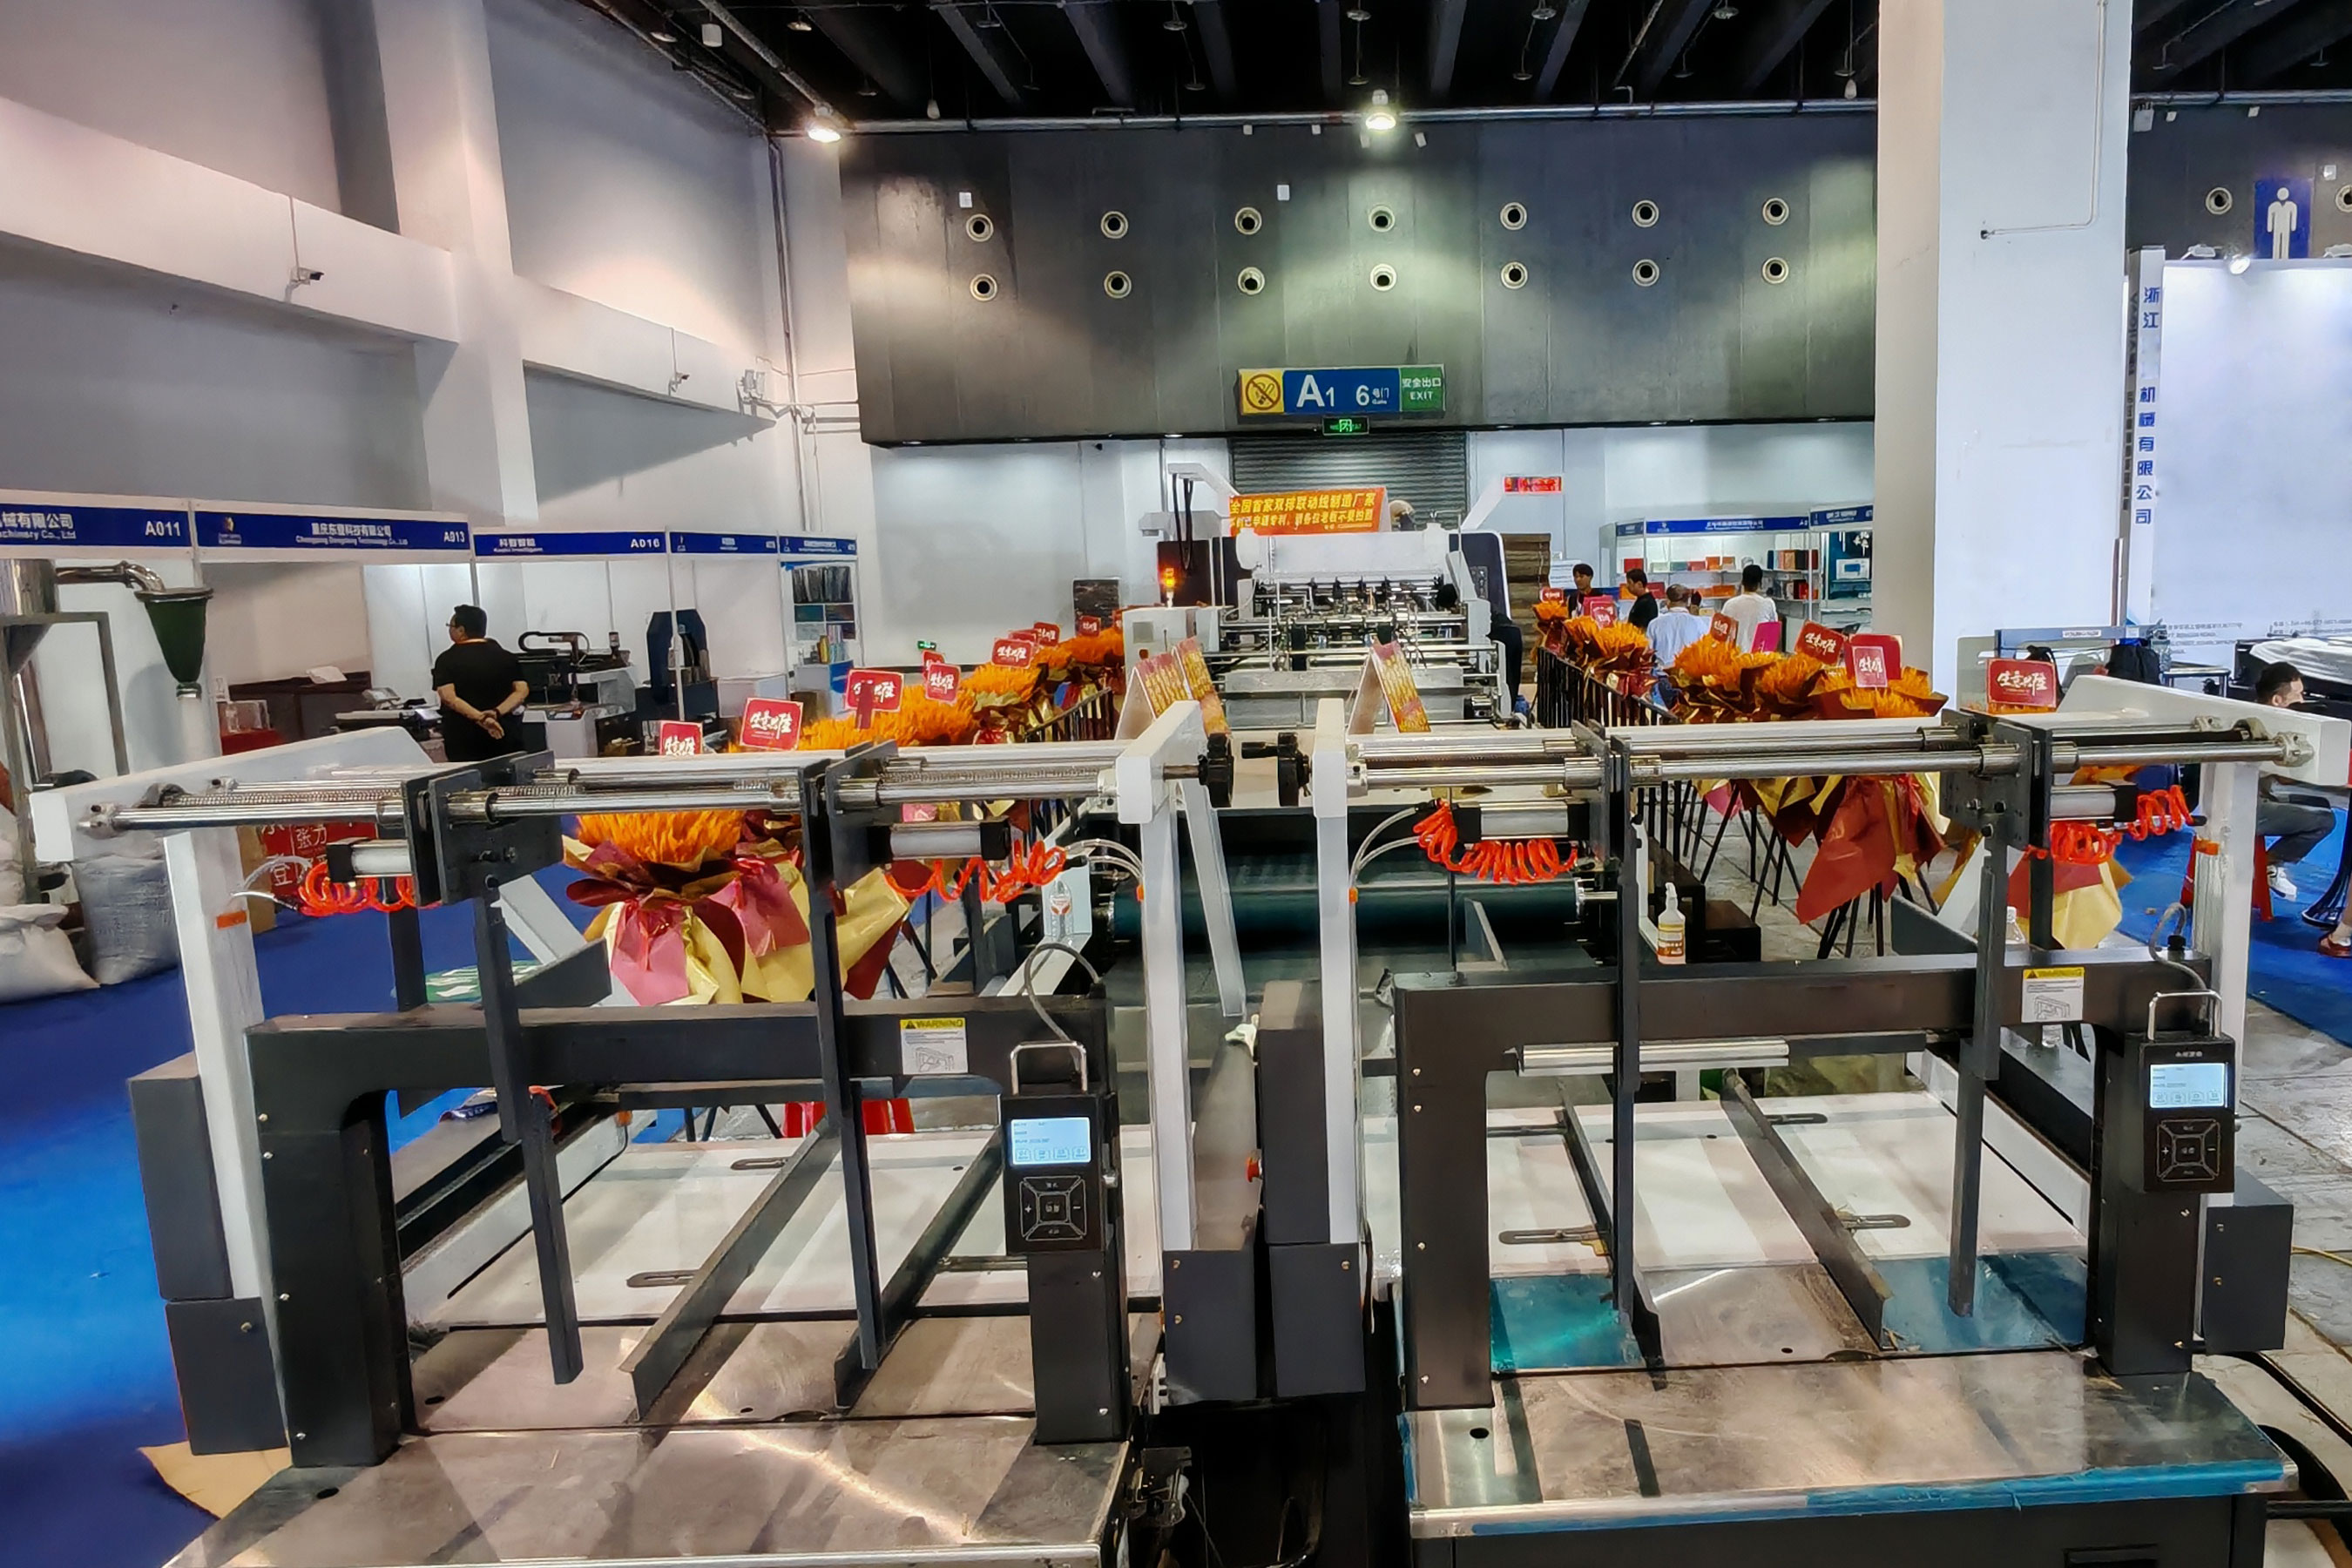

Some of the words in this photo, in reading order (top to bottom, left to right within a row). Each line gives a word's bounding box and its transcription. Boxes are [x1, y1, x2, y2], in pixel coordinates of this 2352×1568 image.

[1402, 377, 1442, 389] 安全出口
[1409, 391, 1434, 401] EXIT
[0, 511, 74, 530] 械有限公司
[145, 520, 181, 537] A011
